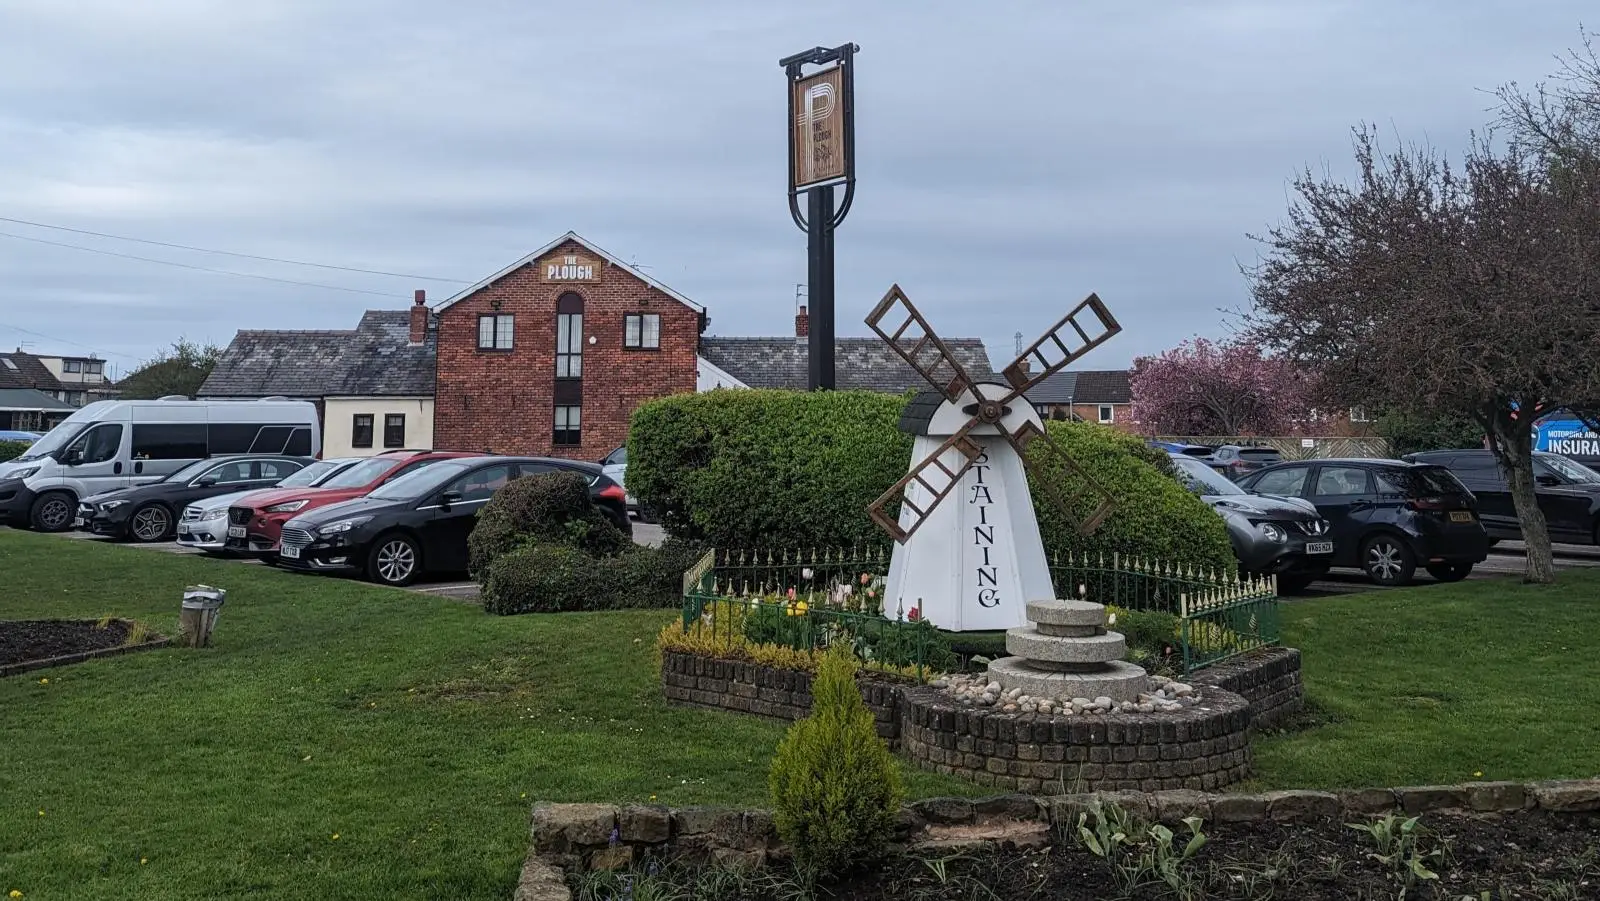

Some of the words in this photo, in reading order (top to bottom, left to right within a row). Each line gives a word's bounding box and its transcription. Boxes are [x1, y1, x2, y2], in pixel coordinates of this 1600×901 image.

[564, 256, 577, 265] THE
[547, 265, 593, 280] PLOUGH
[1548, 439, 1600, 456] INSURA
